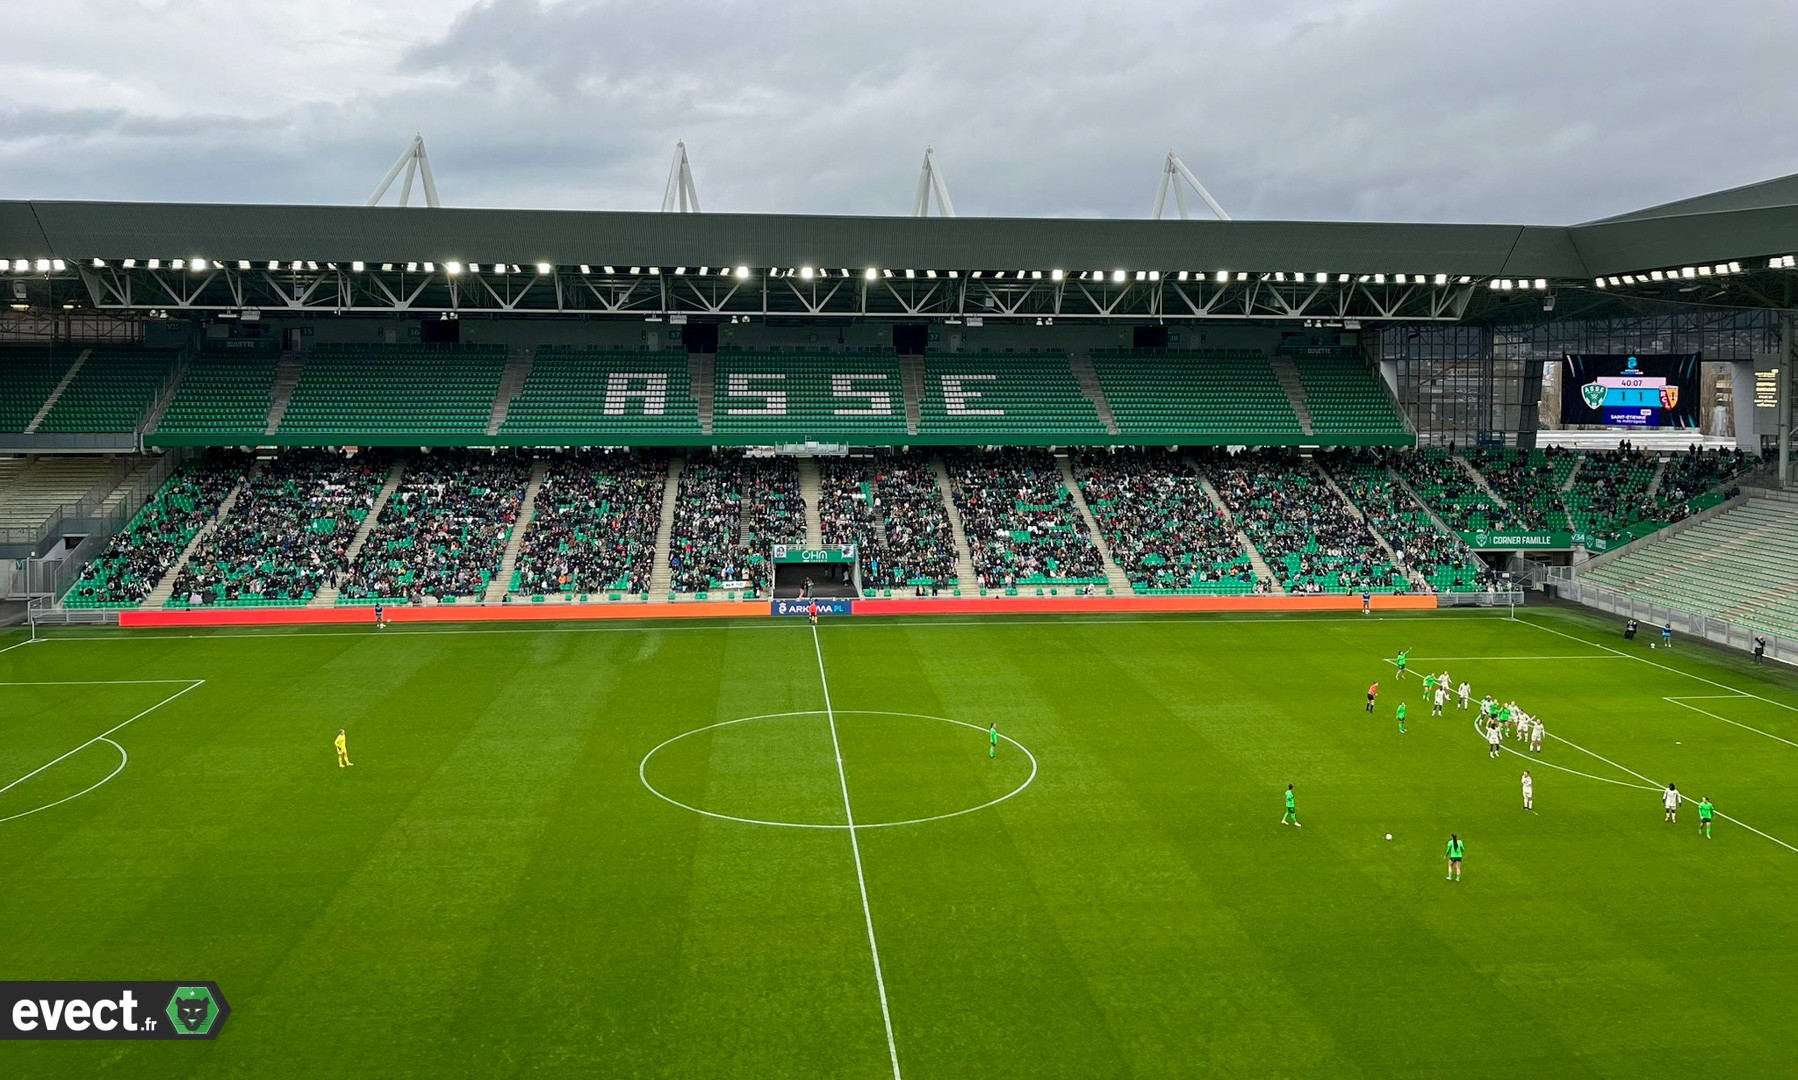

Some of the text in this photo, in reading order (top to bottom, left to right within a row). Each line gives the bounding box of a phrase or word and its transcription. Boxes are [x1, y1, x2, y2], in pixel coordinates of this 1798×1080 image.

[409, 328, 420, 336] 36
[1621, 379, 1643, 387] 40:07
[1584, 385, 1605, 393] ASSE
[603, 372, 1005, 416] ASSE
[1660, 390, 1671, 409] RCL
[1493, 535, 1551, 545] CORNER FAMILLE
[1571, 533, 1585, 541] V34
[802, 550, 828, 561] OHM
[789, 604, 844, 613] ARKMA PL
